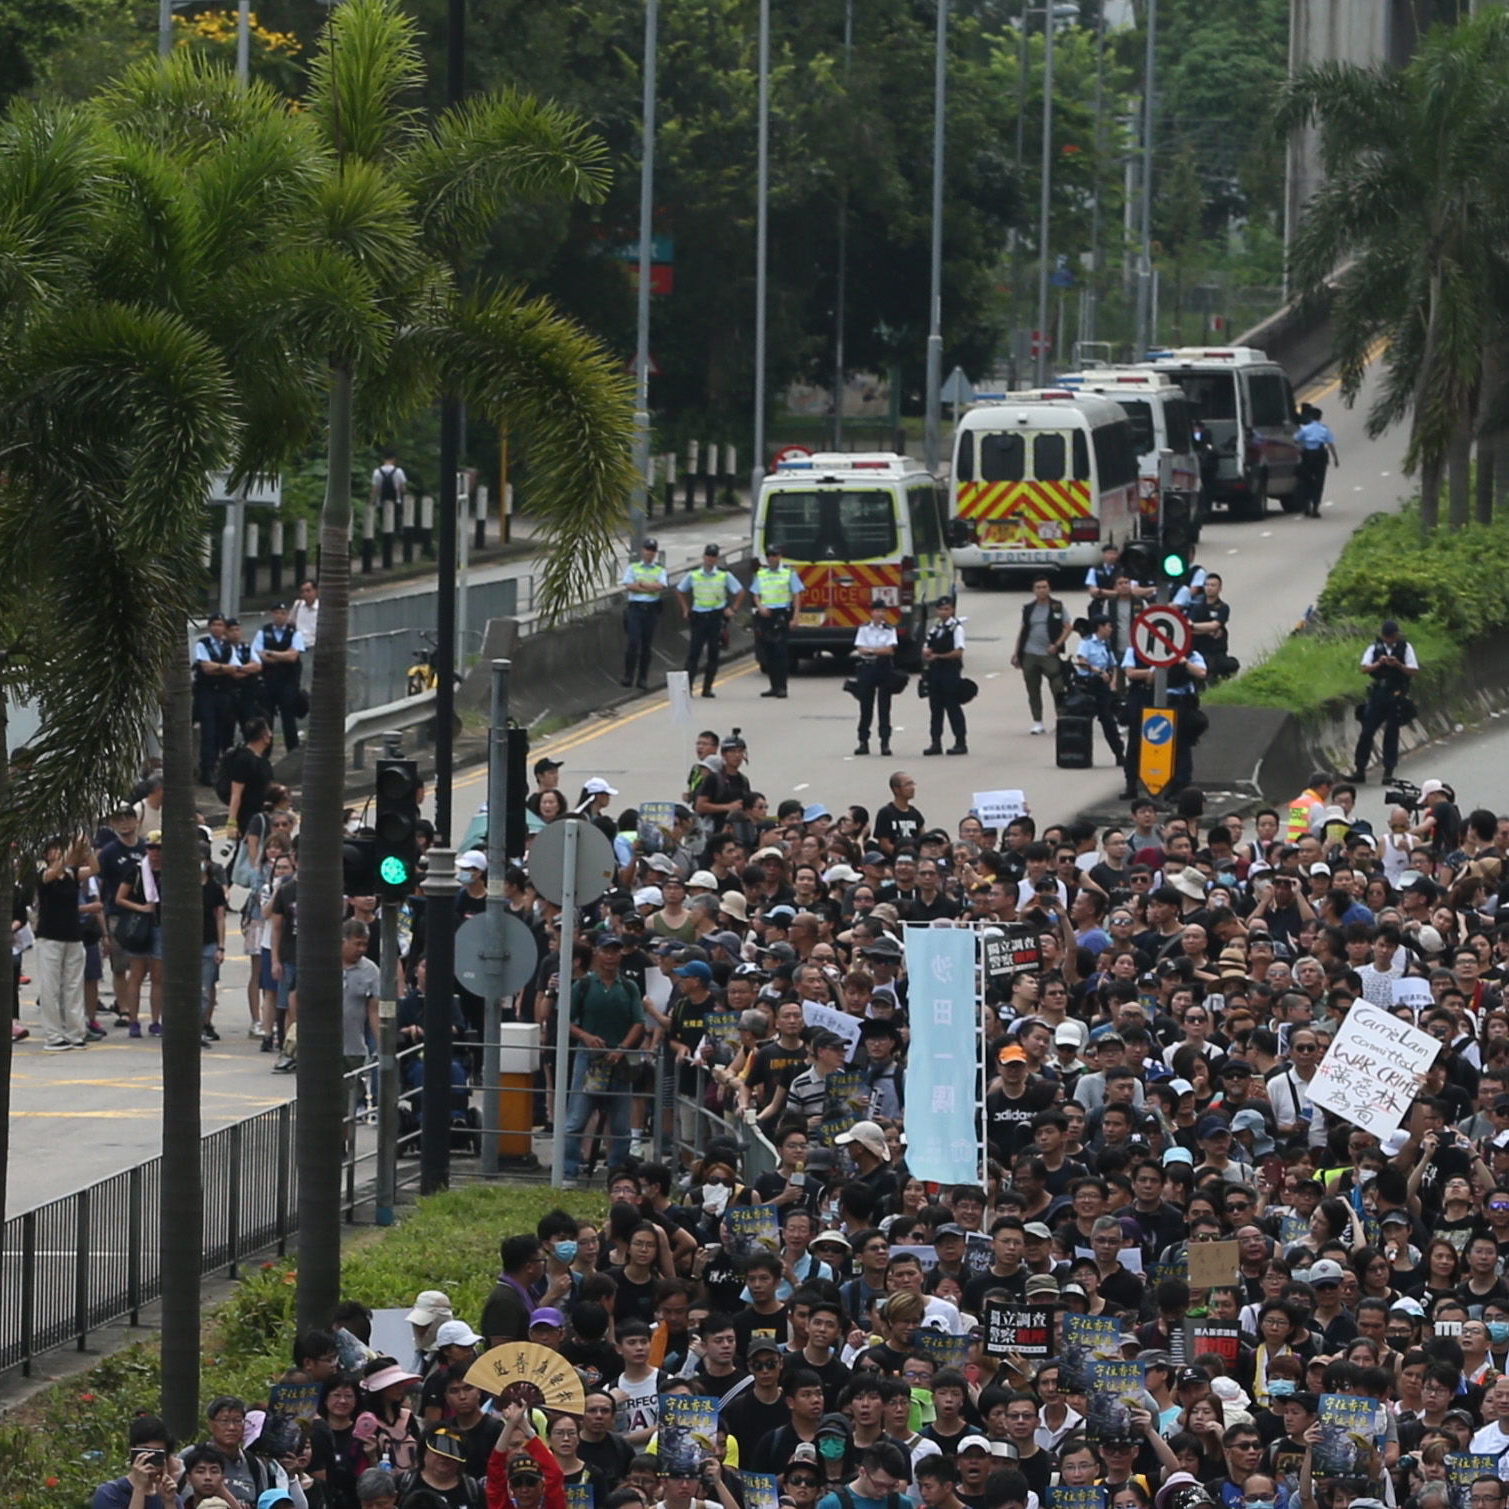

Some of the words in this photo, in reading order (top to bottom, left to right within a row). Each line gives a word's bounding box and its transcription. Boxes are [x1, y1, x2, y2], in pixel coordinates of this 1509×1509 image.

[994, 551, 1054, 562] POLICE
[803, 587, 858, 602] POLICE
[993, 1108, 1039, 1121] adidas
